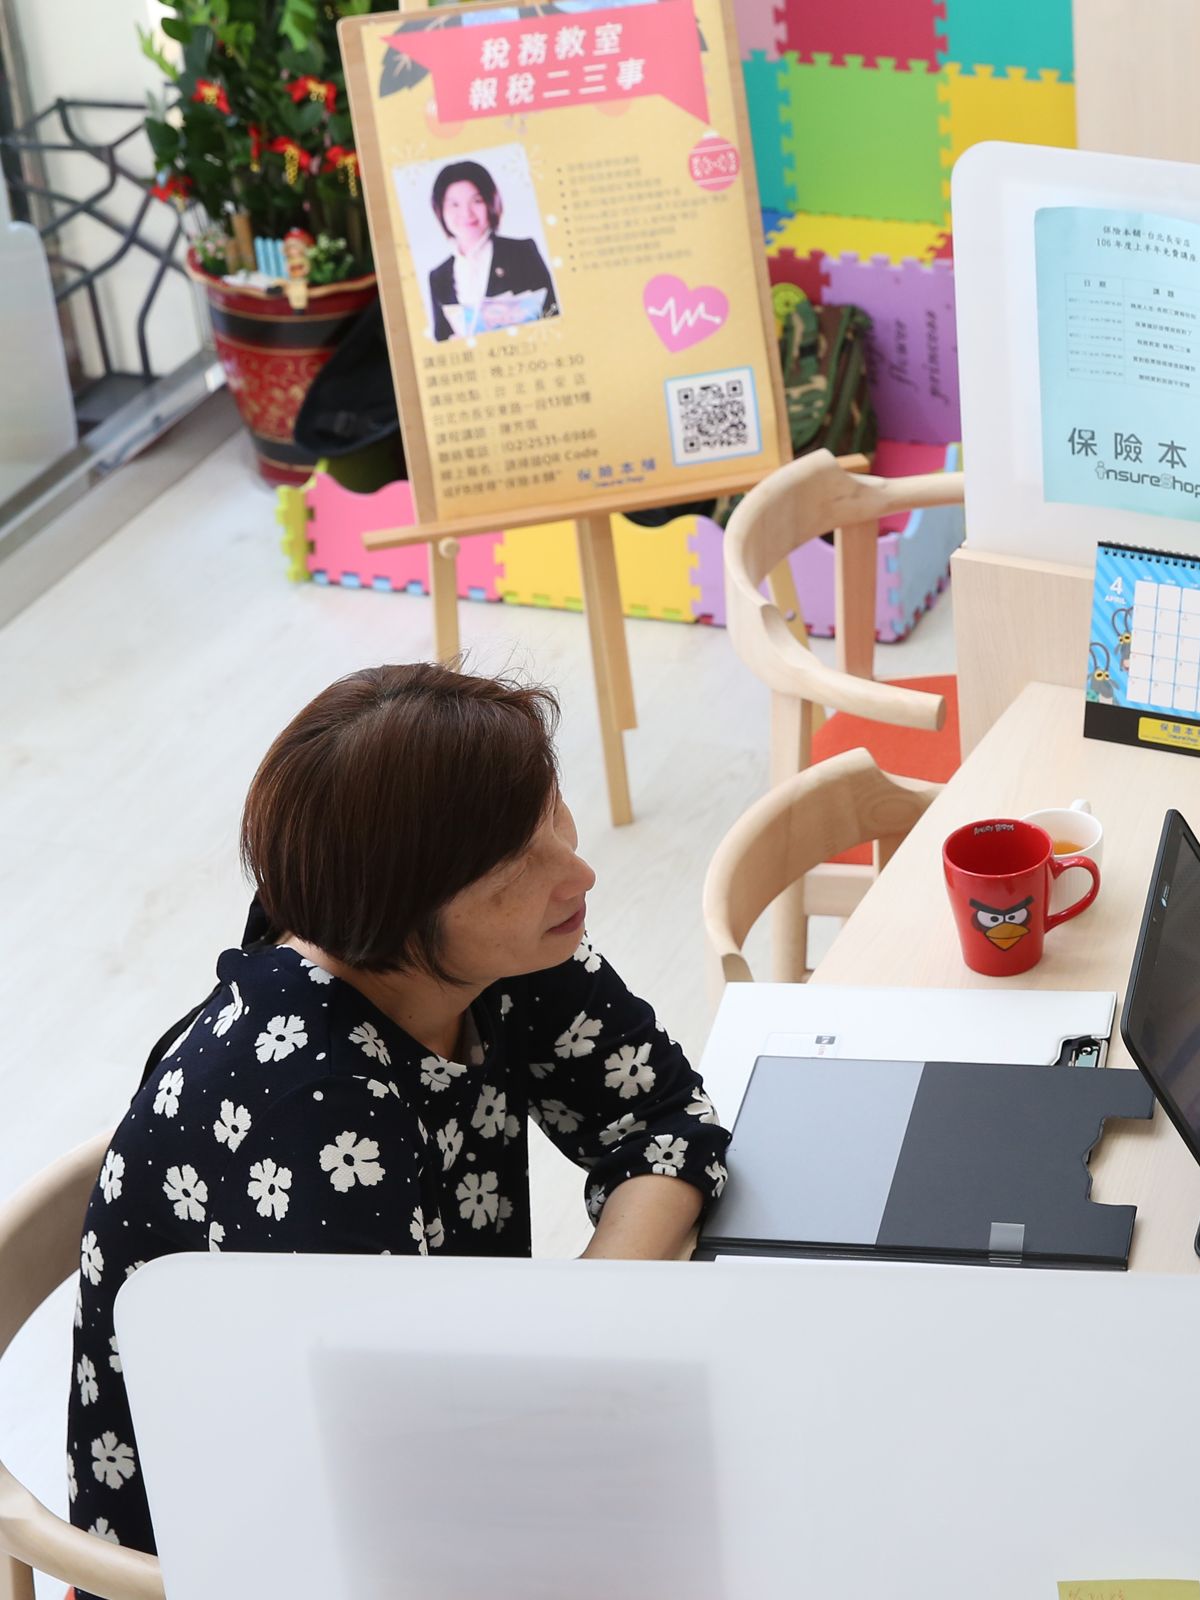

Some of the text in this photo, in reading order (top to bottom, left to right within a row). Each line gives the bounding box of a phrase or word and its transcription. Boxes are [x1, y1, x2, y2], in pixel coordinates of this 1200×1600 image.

[480, 22, 623, 71] 稅務教室
[468, 58, 646, 111] 報稅二三事
[1110, 576, 1123, 595] 4
